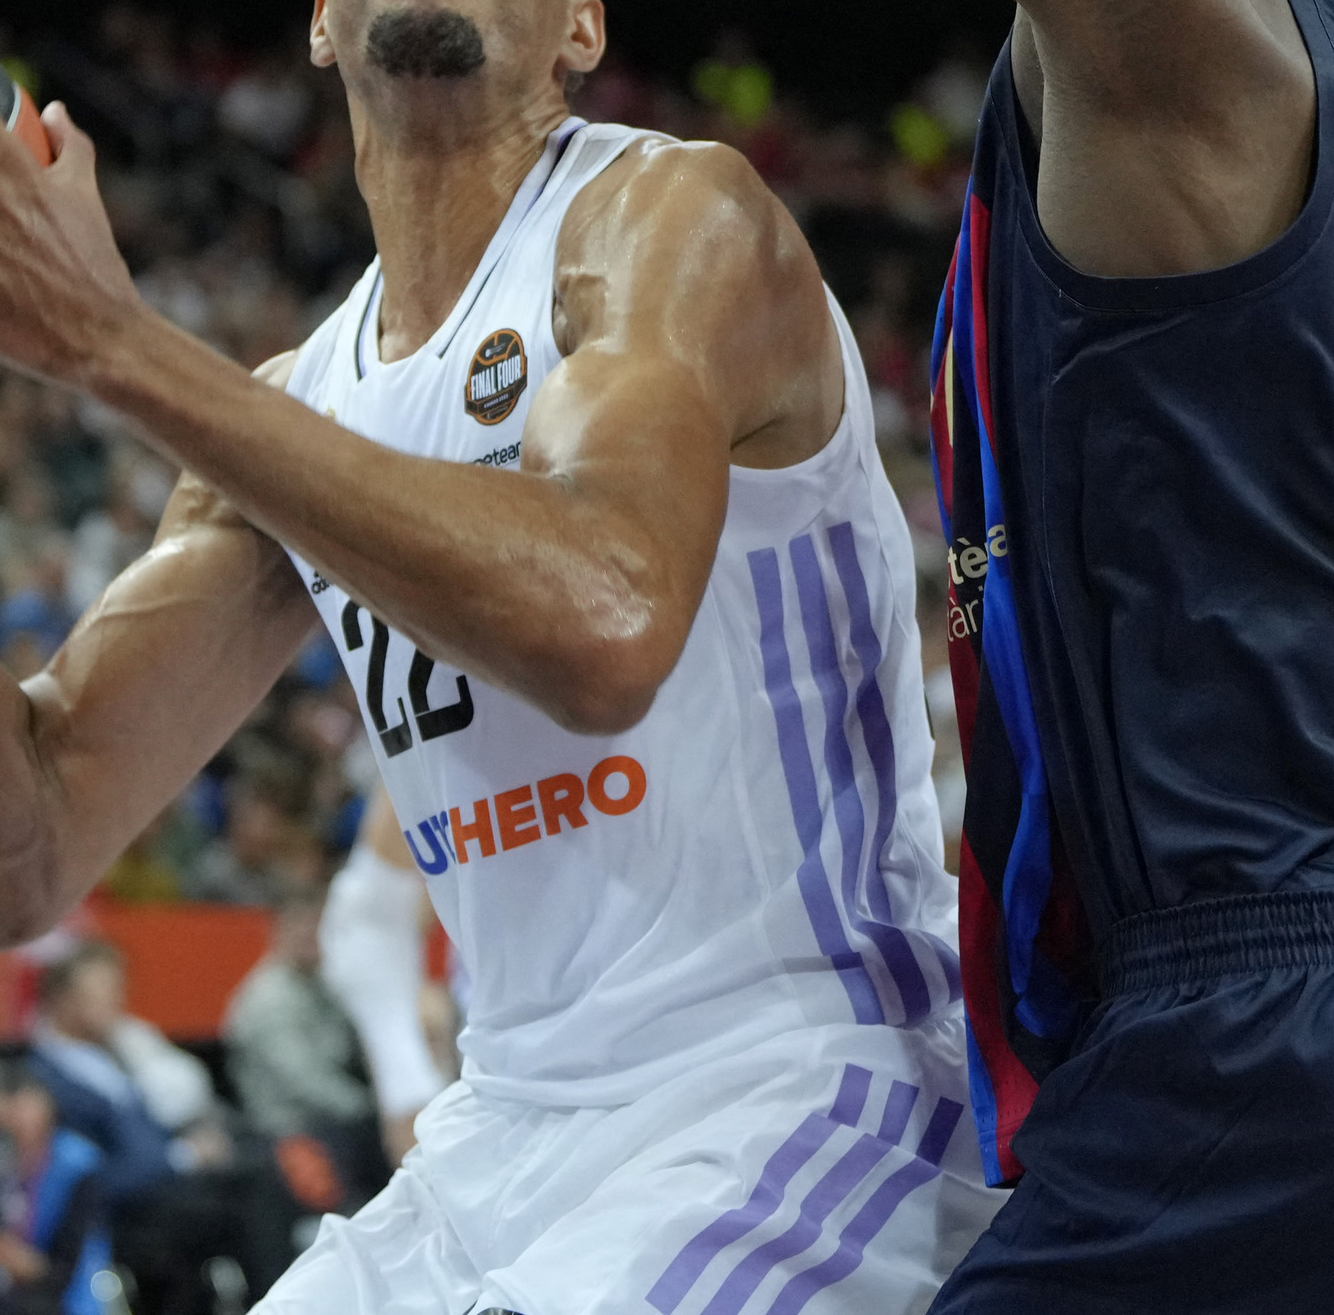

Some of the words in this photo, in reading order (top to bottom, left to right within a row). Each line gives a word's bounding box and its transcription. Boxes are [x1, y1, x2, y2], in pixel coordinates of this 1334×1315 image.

[470, 365, 498, 401] FINAL
[497, 354, 522, 391] FOUR
[341, 599, 475, 759] 22
